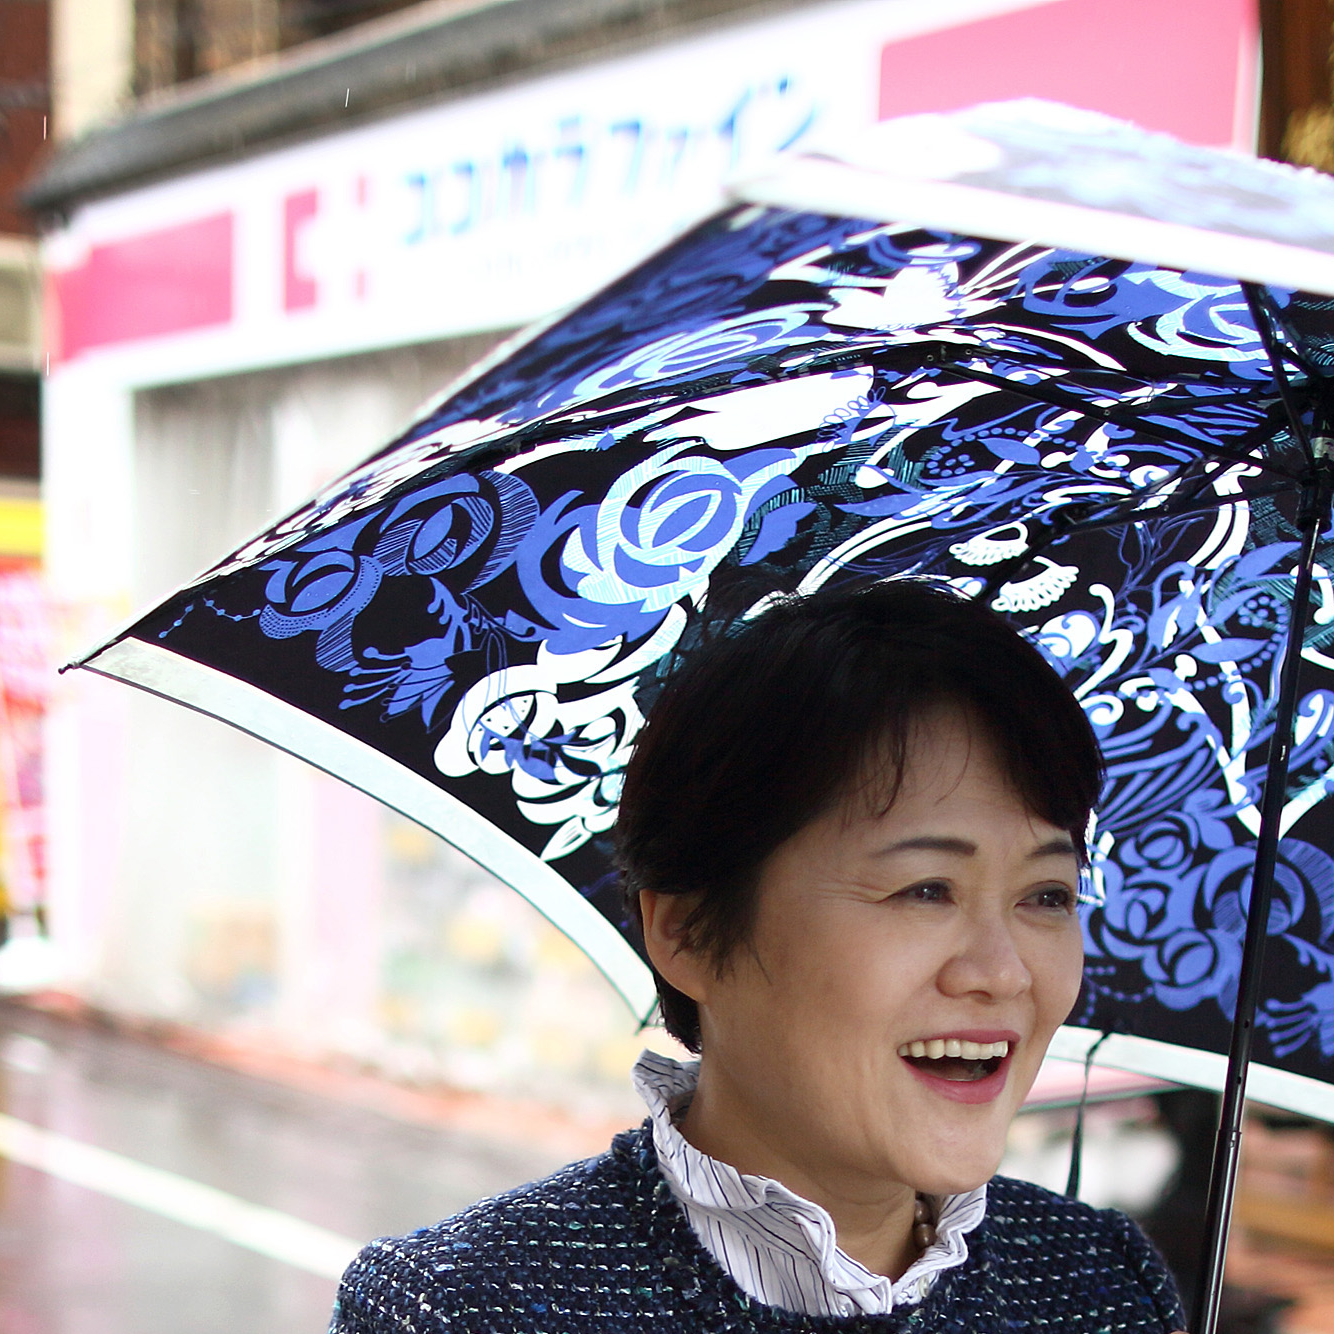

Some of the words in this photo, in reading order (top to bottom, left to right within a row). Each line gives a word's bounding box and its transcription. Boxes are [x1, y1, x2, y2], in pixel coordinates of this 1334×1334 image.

[402, 74, 819, 250] ココカラファイン
